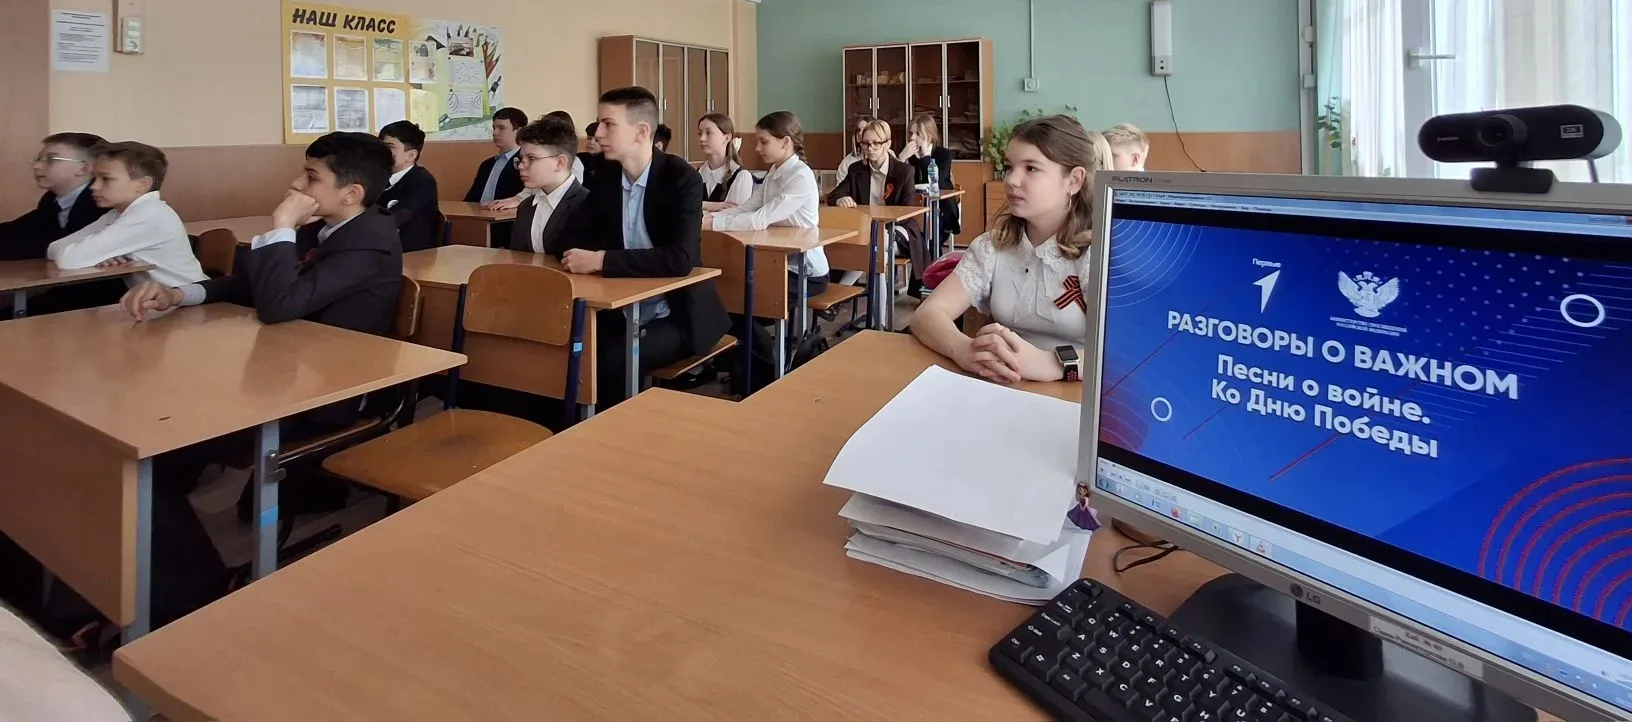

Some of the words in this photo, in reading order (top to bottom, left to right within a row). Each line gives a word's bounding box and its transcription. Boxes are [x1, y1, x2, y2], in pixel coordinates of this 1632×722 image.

[292, 8, 337, 27] НАШ
[343, 15, 396, 34] КЛАСС
[1112, 176, 1153, 184] FLATRON
[1252, 258, 1282, 267] Первые
[1167, 310, 1314, 359] РАЗГОВОРЫ
[1321, 339, 1346, 364] О
[1353, 345, 1519, 400] ВАЖНОМ
[1217, 354, 1294, 393] Песни
[1302, 379, 1320, 397] о
[1327, 384, 1432, 425] войне.
[1211, 378, 1241, 404] Ко
[1246, 390, 1307, 423] Дню
[1314, 401, 1439, 459] Победы
[1306, 592, 1321, 605] LG
[1088, 617, 1096, 625] Q
[1109, 630, 1119, 638] W
[1099, 646, 1107, 654] S
[1131, 644, 1140, 652] E
[1071, 652, 1080, 660] Z
[1155, 659, 1164, 668] R
[1095, 667, 1104, 676] X
[1181, 673, 1190, 681] T
[1119, 683, 1128, 691] C
[1173, 694, 1182, 702] G
[1208, 690, 1217, 698] Y
[1145, 699, 1153, 707] V
[1199, 710, 1209, 720] H
[1236, 708, 1246, 717] U
